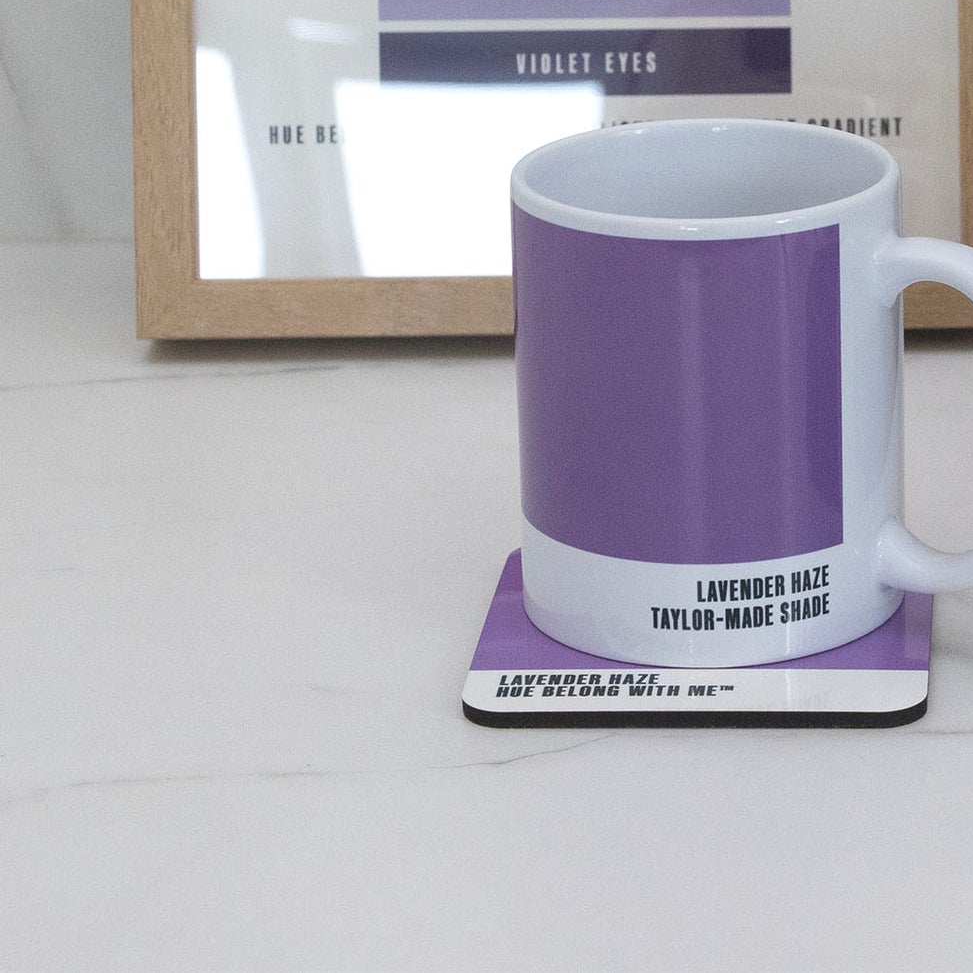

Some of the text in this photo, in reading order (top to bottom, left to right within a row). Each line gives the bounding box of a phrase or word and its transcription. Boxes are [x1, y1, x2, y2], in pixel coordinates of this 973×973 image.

[516, 52, 657, 74] VIOLET EYES
[269, 126, 304, 144] HUE
[697, 565, 830, 602] LAVENDER HAZE
[651, 593, 830, 631] TAYLOR-MADE SHADE
[499, 674, 660, 685] LAVENDER HAZE
[496, 685, 534, 697] HUE
[541, 685, 622, 697] BELONG
[628, 685, 684, 696] WITH
